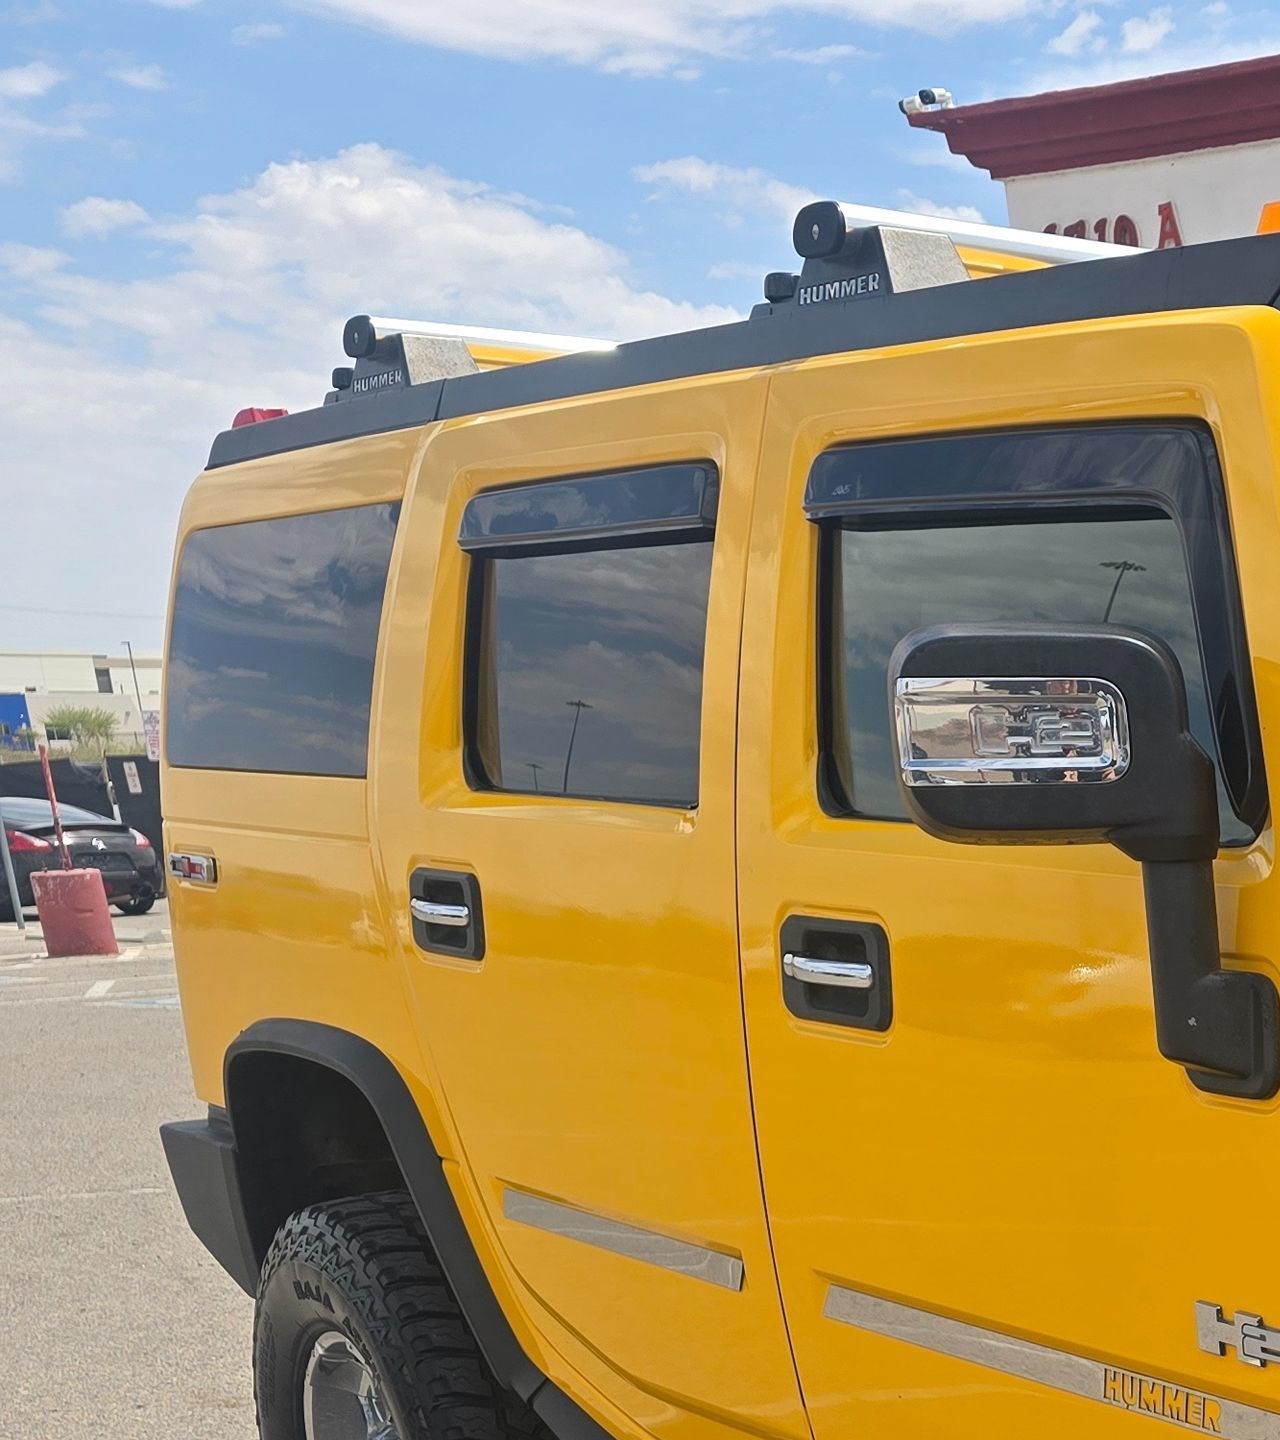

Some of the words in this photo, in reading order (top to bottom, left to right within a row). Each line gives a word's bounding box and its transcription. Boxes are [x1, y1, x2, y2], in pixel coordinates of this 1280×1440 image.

[799, 272, 880, 305] HUMMER
[353, 370, 402, 393] HUMMER
[1103, 1367, 1222, 1434] HUMMER
